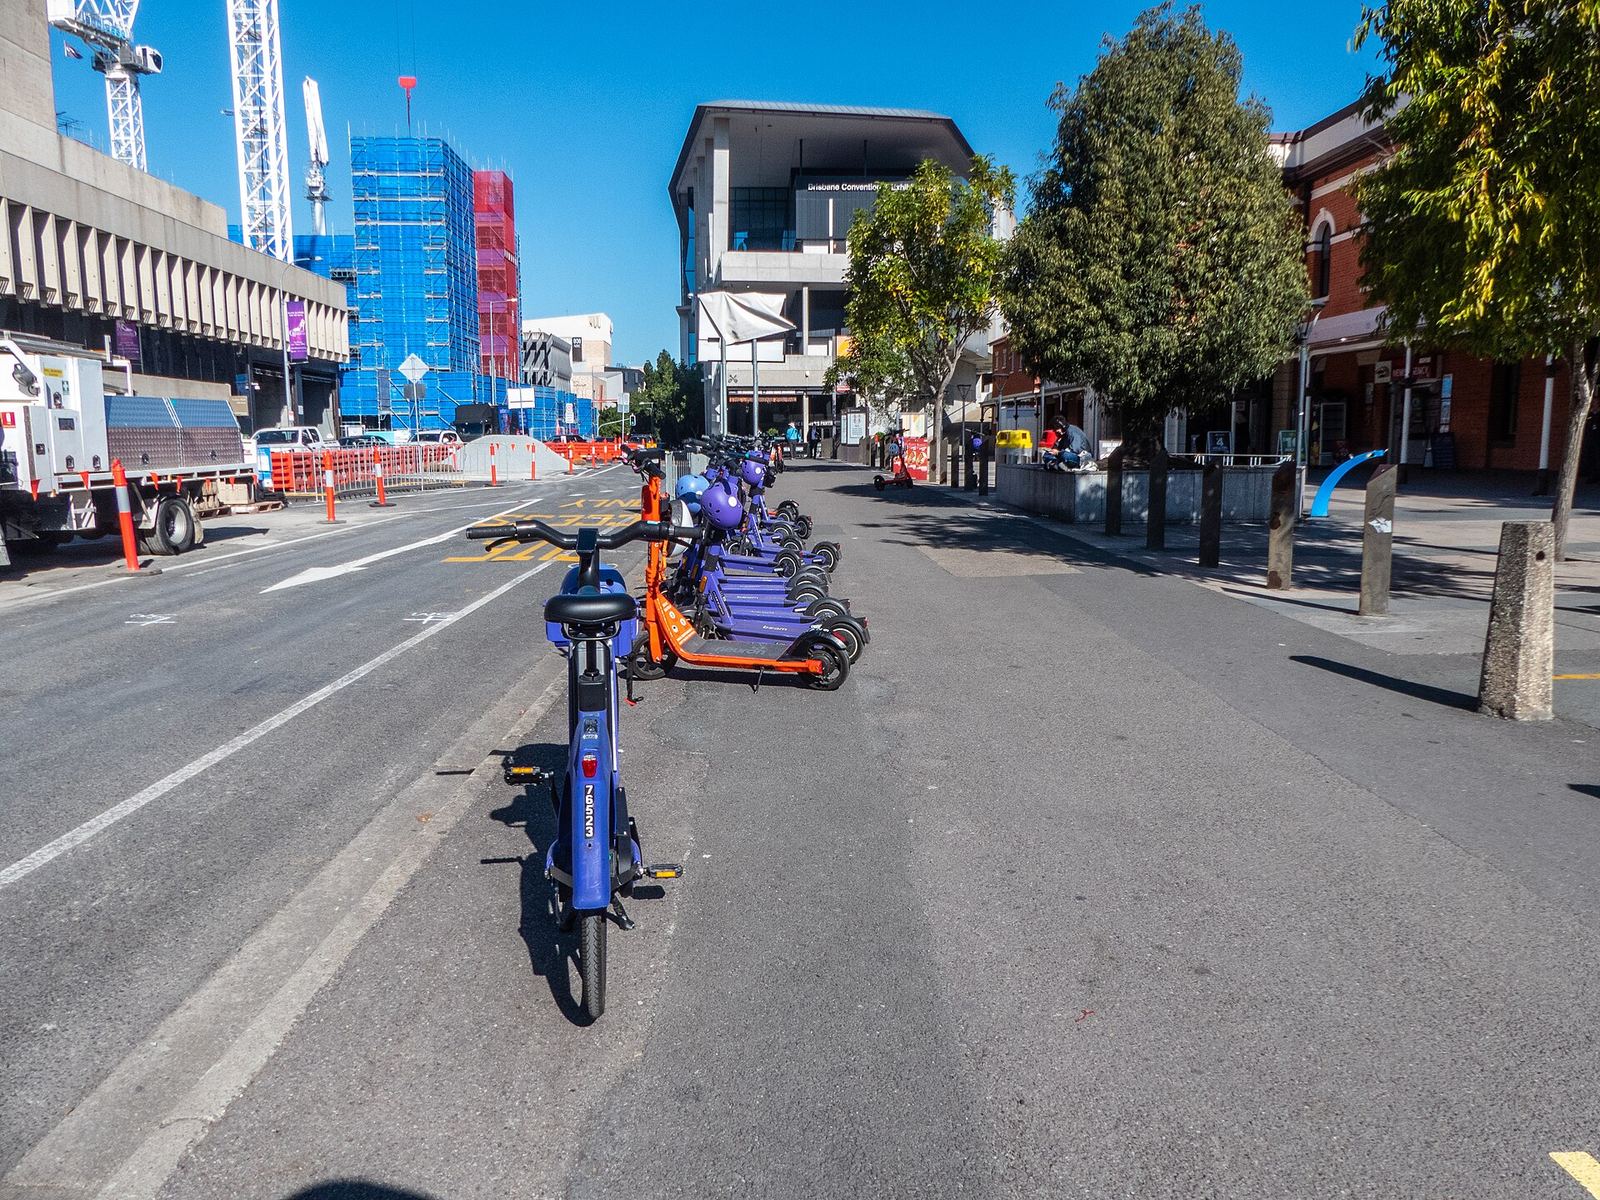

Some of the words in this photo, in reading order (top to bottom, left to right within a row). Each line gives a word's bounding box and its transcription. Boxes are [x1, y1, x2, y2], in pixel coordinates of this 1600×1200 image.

[807, 183, 840, 191] Brisbane
[559, 499, 642, 508] NLY
[585, 785, 595, 837] 76523
